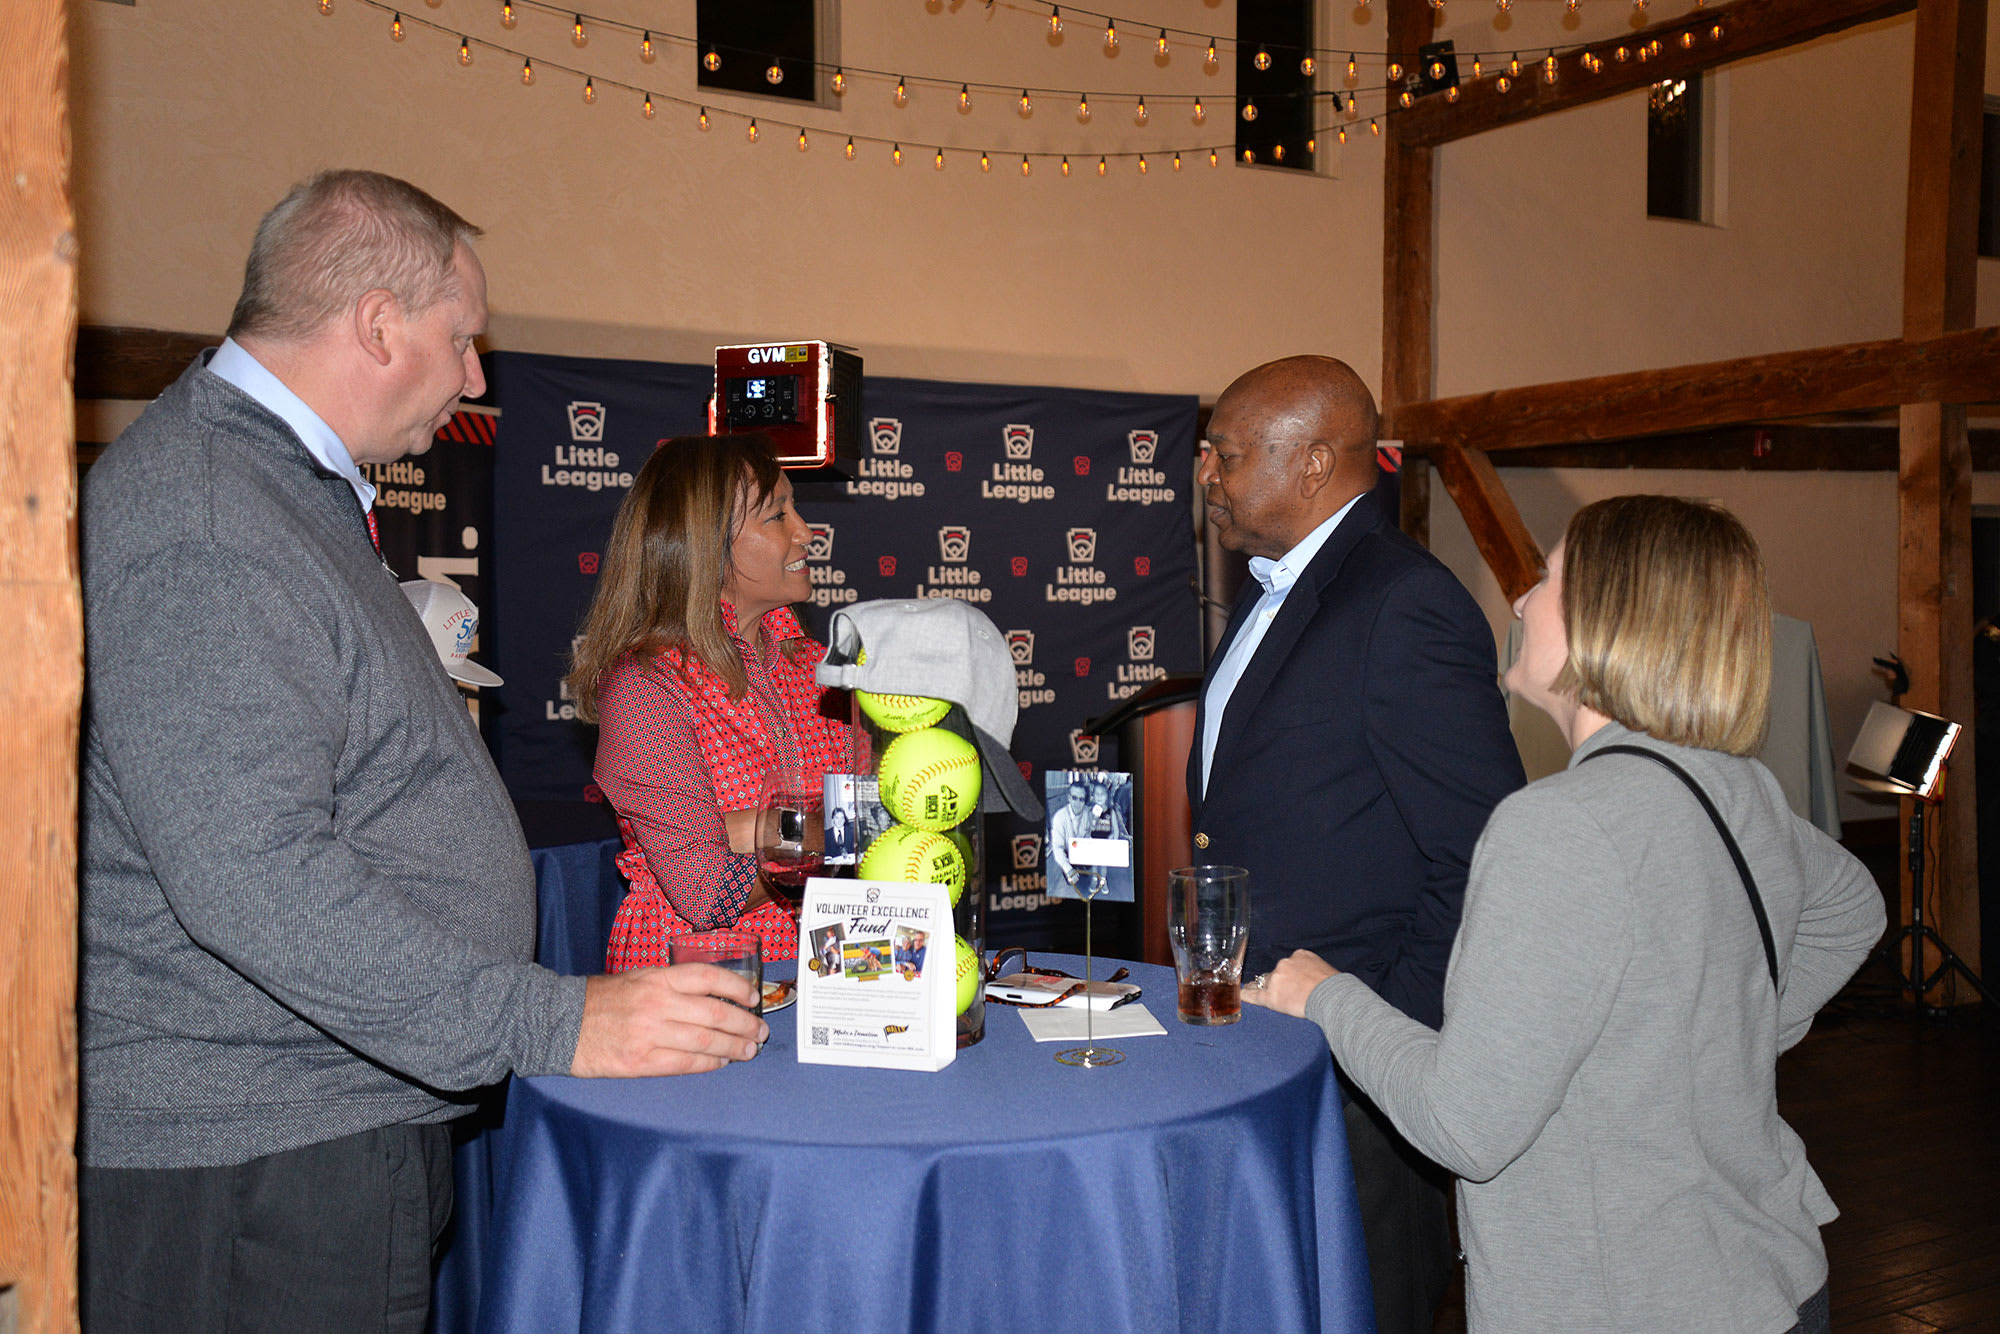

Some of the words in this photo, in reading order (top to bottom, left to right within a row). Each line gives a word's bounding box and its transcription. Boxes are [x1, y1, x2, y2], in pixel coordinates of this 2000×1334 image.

[748, 347, 785, 364] GVM
[556, 445, 620, 467] Little
[375, 461, 425, 486] Little
[542, 465, 633, 491] League
[859, 458, 913, 479] Little
[993, 462, 1045, 483] Little
[1118, 466, 1166, 486] Little
[375, 482, 447, 515] League
[847, 479, 925, 501] League
[982, 479, 1055, 504] League
[1107, 483, 1175, 506] League
[809, 565, 846, 585] ttle
[928, 566, 981, 586] Little
[1057, 566, 1106, 586] Little
[917, 584, 992, 602] League
[1046, 583, 1117, 606] League
[443, 609, 470, 630] LITTLE
[816, 903, 869, 917] VOLUNTEER
[871, 905, 930, 919] EXCELLENCE
[849, 917, 892, 936] Fund
